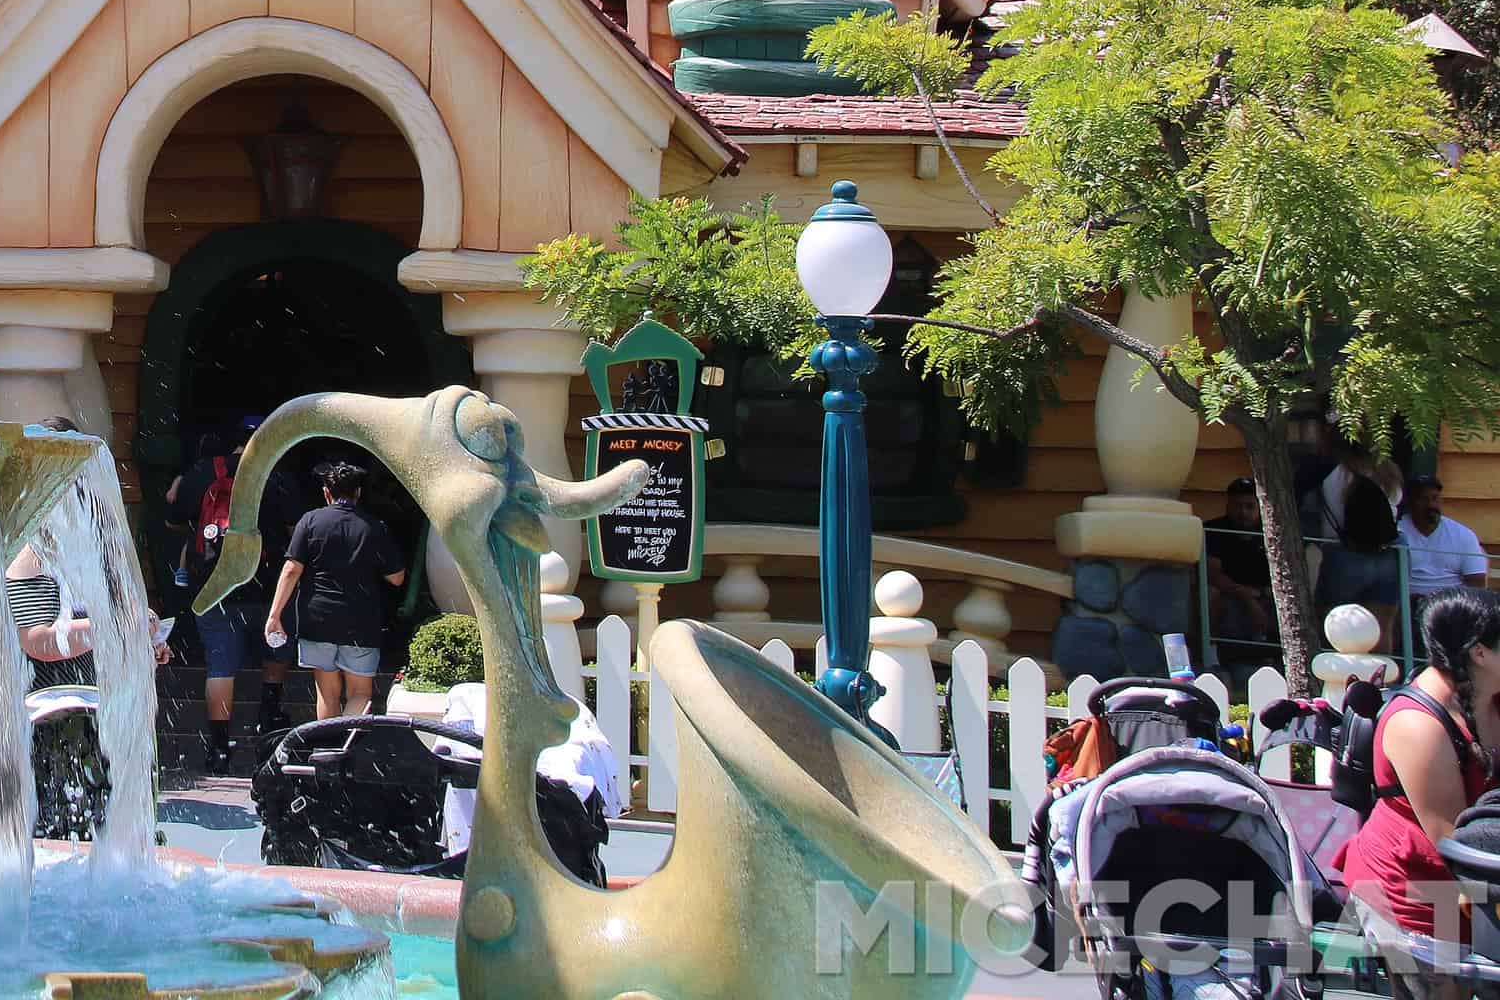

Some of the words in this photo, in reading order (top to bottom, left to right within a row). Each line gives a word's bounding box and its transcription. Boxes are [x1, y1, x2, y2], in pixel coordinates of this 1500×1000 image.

[609, 439, 637, 450] MEET
[643, 439, 684, 451] MICKEY
[661, 509, 687, 519] HOUSE
